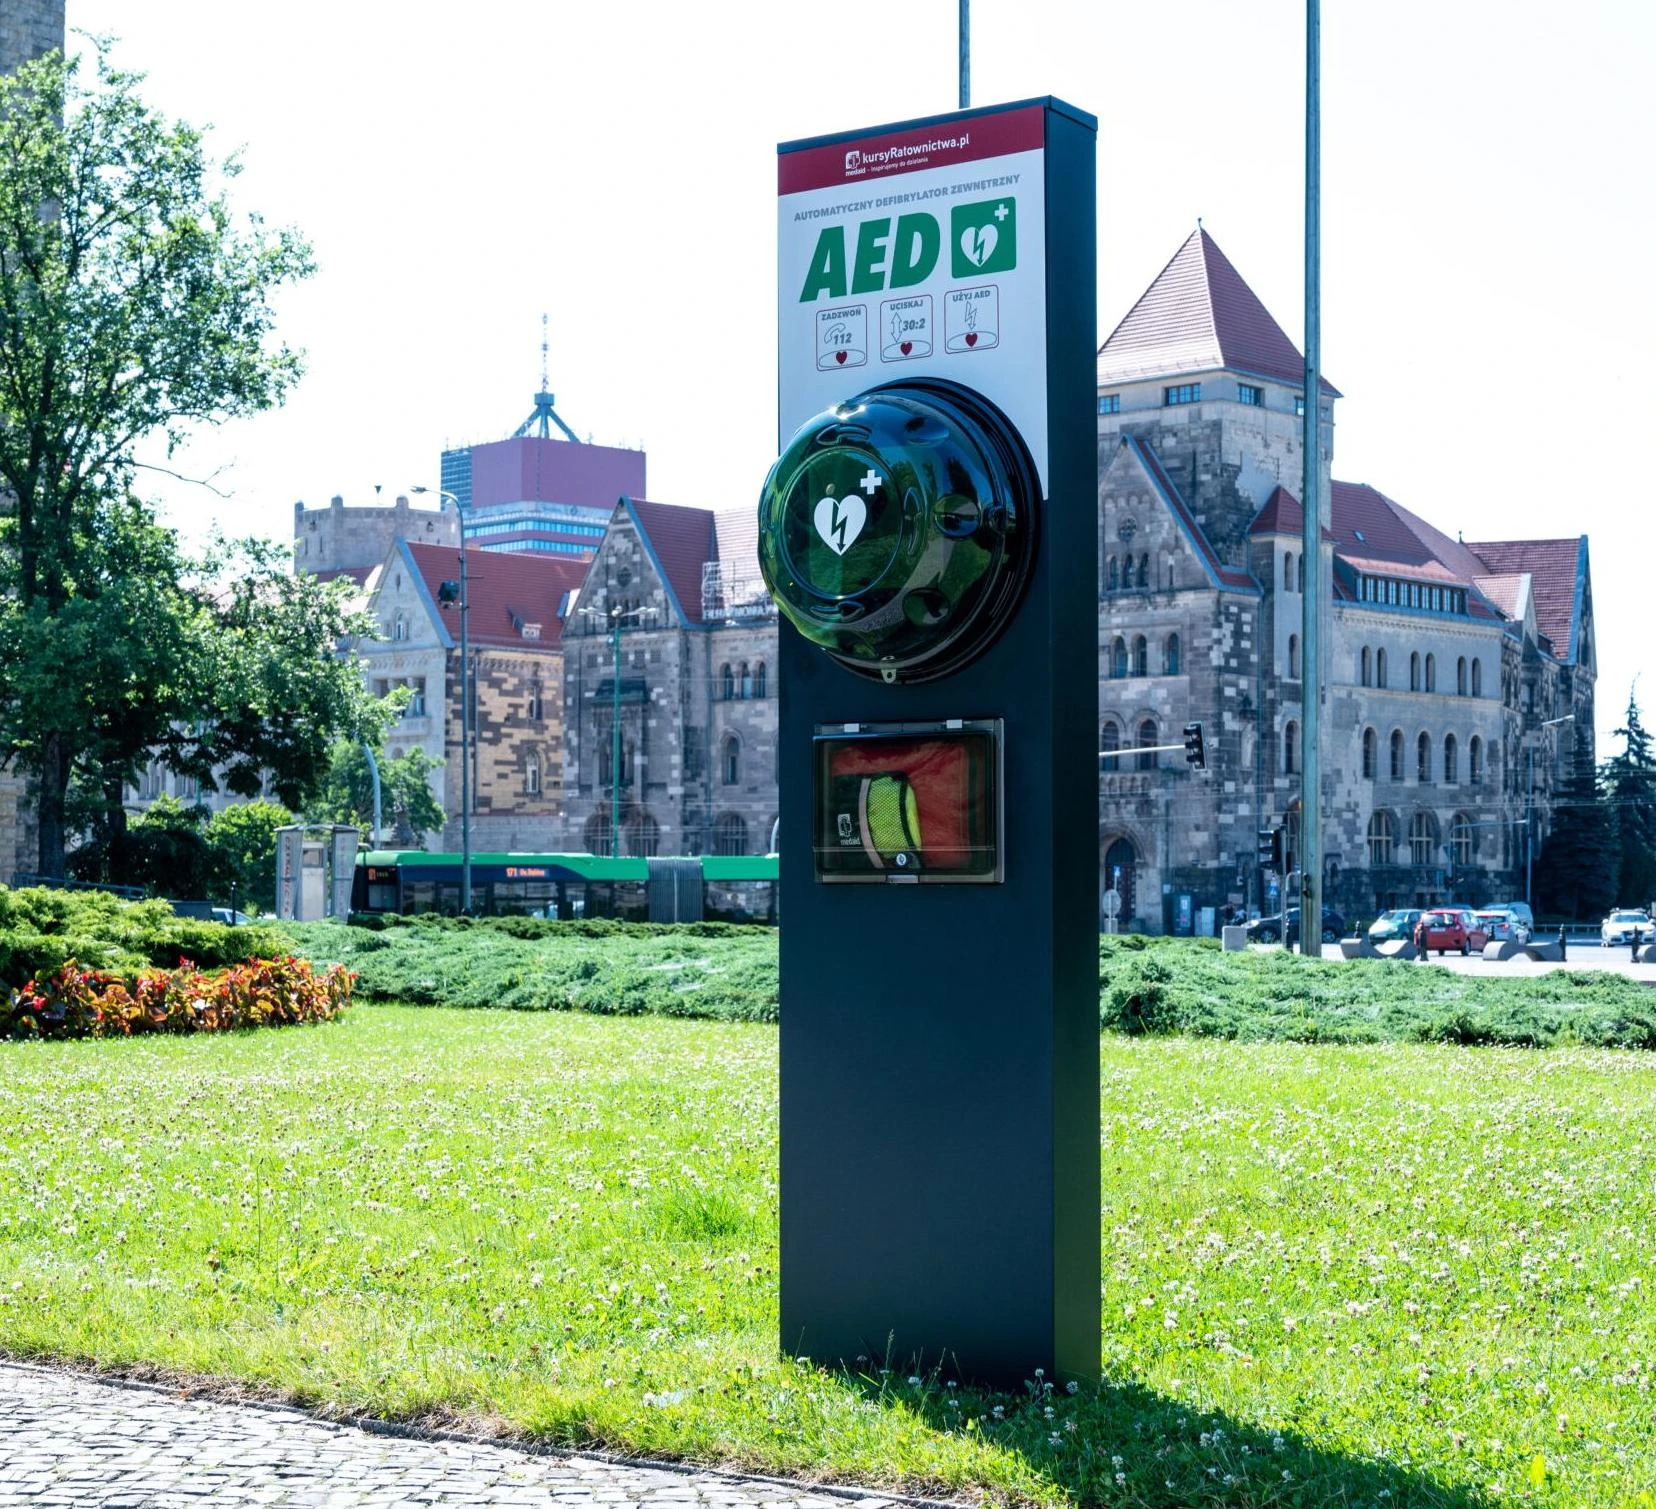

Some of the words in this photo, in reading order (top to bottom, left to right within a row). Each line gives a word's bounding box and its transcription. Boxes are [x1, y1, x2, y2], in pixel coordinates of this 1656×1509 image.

[863, 134, 969, 163] kursyRatownictwa.pl
[794, 199, 873, 221] AUTOMATYCZNY
[876, 187, 948, 207] DEFIBRYLATOR
[951, 174, 1020, 195] ZEWNĘTRZNY
[799, 212, 940, 302] AED
[952, 292, 973, 303] UŻYJ
[974, 290, 991, 299] AED
[890, 299, 924, 312] UCISKAJ
[821, 308, 861, 321] ZADZWOŃ
[903, 318, 925, 332] 30:2
[834, 333, 852, 345] 112
